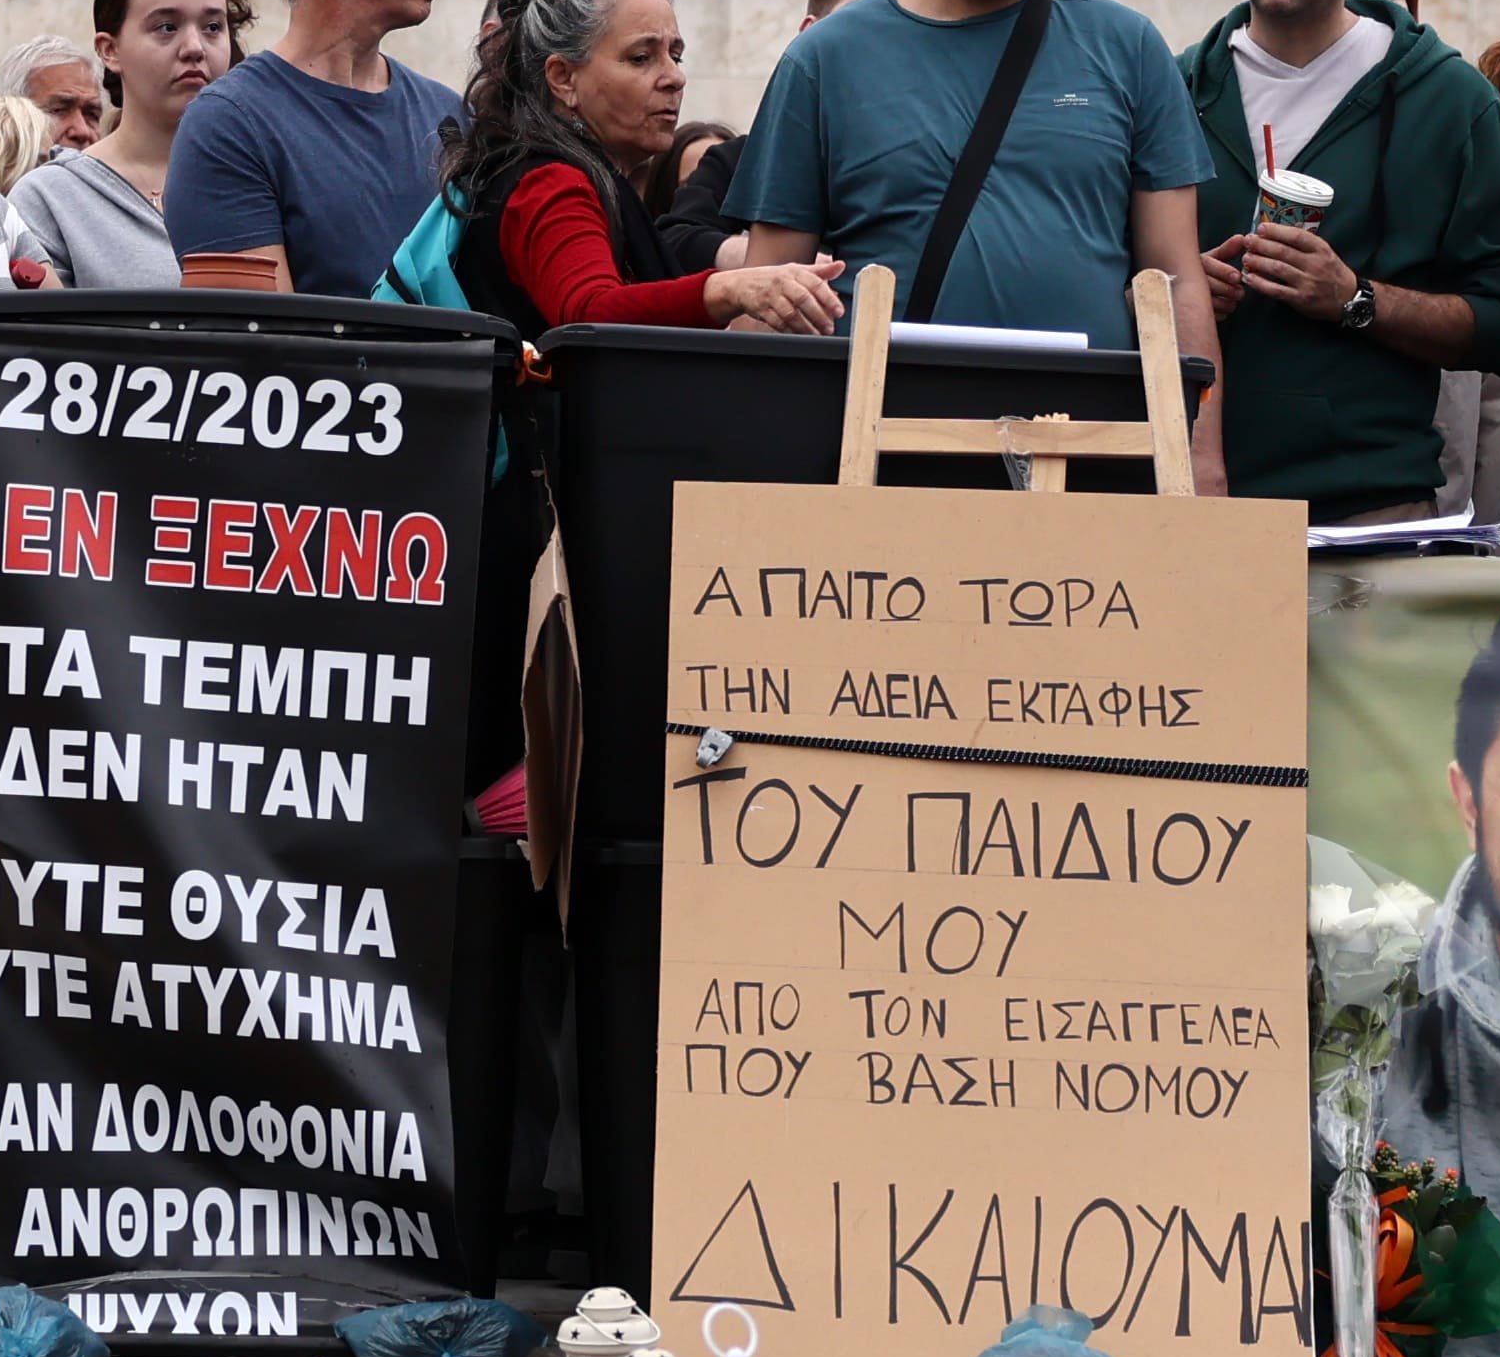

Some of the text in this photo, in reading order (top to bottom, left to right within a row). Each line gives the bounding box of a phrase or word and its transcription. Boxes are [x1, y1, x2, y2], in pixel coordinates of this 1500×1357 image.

[144, 494, 448, 605] ΞΕΧΝΩ
[129, 635, 431, 726] ΤΕΜΠΗ
[685, 663, 1204, 728] ΤΗΝ ΑΔΕΙΑ ΕΚΤΑΦΗΣ
[167, 739, 368, 823] ΗΤΑΝ
[672, 766, 1252, 886] ΤΟΥ ΠΑΙΔΙΟΥ
[169, 869, 398, 959] ΘΥΣΙΑ
[836, 900, 1029, 978] ΜΟΥ
[110, 960, 422, 1054] ΑΤΥΧΗΜΑ
[694, 976, 1281, 1051] ΑΠΟ ΤΟΝ ΕΙΣΑΓΓΕΛΕΑ
[683, 1042, 1249, 1119] ΠΟΥ ΒΑΣΗ ΝΟΜΟΥ
[91, 1082, 427, 1183] ΔΟΛΟΦΟΝΙΑ
[13, 1187, 440, 1260] ΑΝΘΡΩΠΙΝΩΝ
